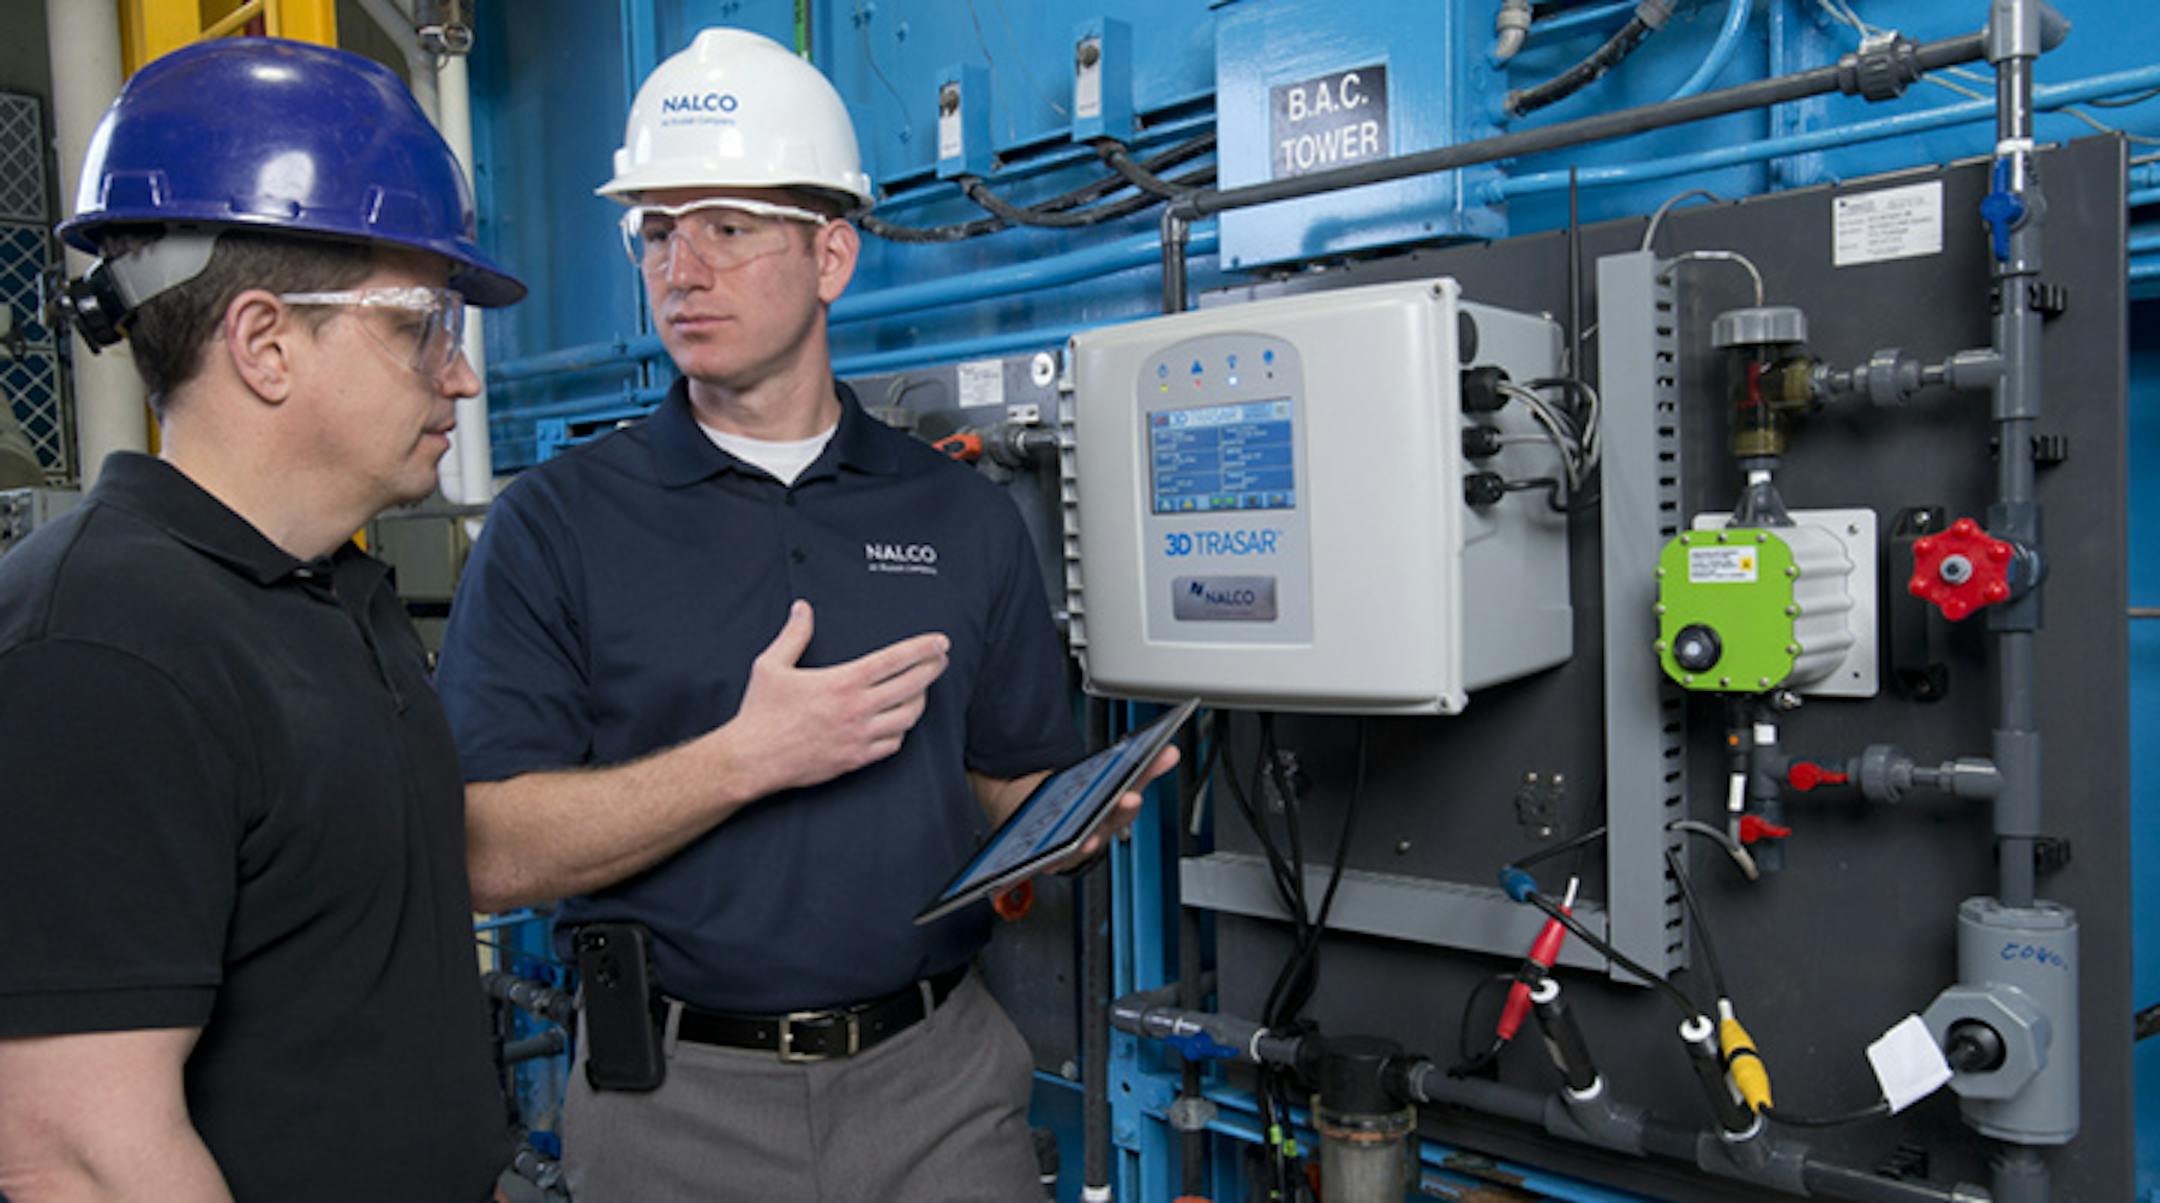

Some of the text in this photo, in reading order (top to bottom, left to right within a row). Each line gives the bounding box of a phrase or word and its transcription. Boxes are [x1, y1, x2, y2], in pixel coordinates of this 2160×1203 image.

[662, 93, 738, 113] NALCO
[1288, 73, 1369, 121] B.A.C.
[1281, 119, 1379, 171] TOWER
[865, 543, 938, 564] NALCO
[1165, 532, 1192, 557] 3D
[1205, 590, 1256, 606] NALCO
